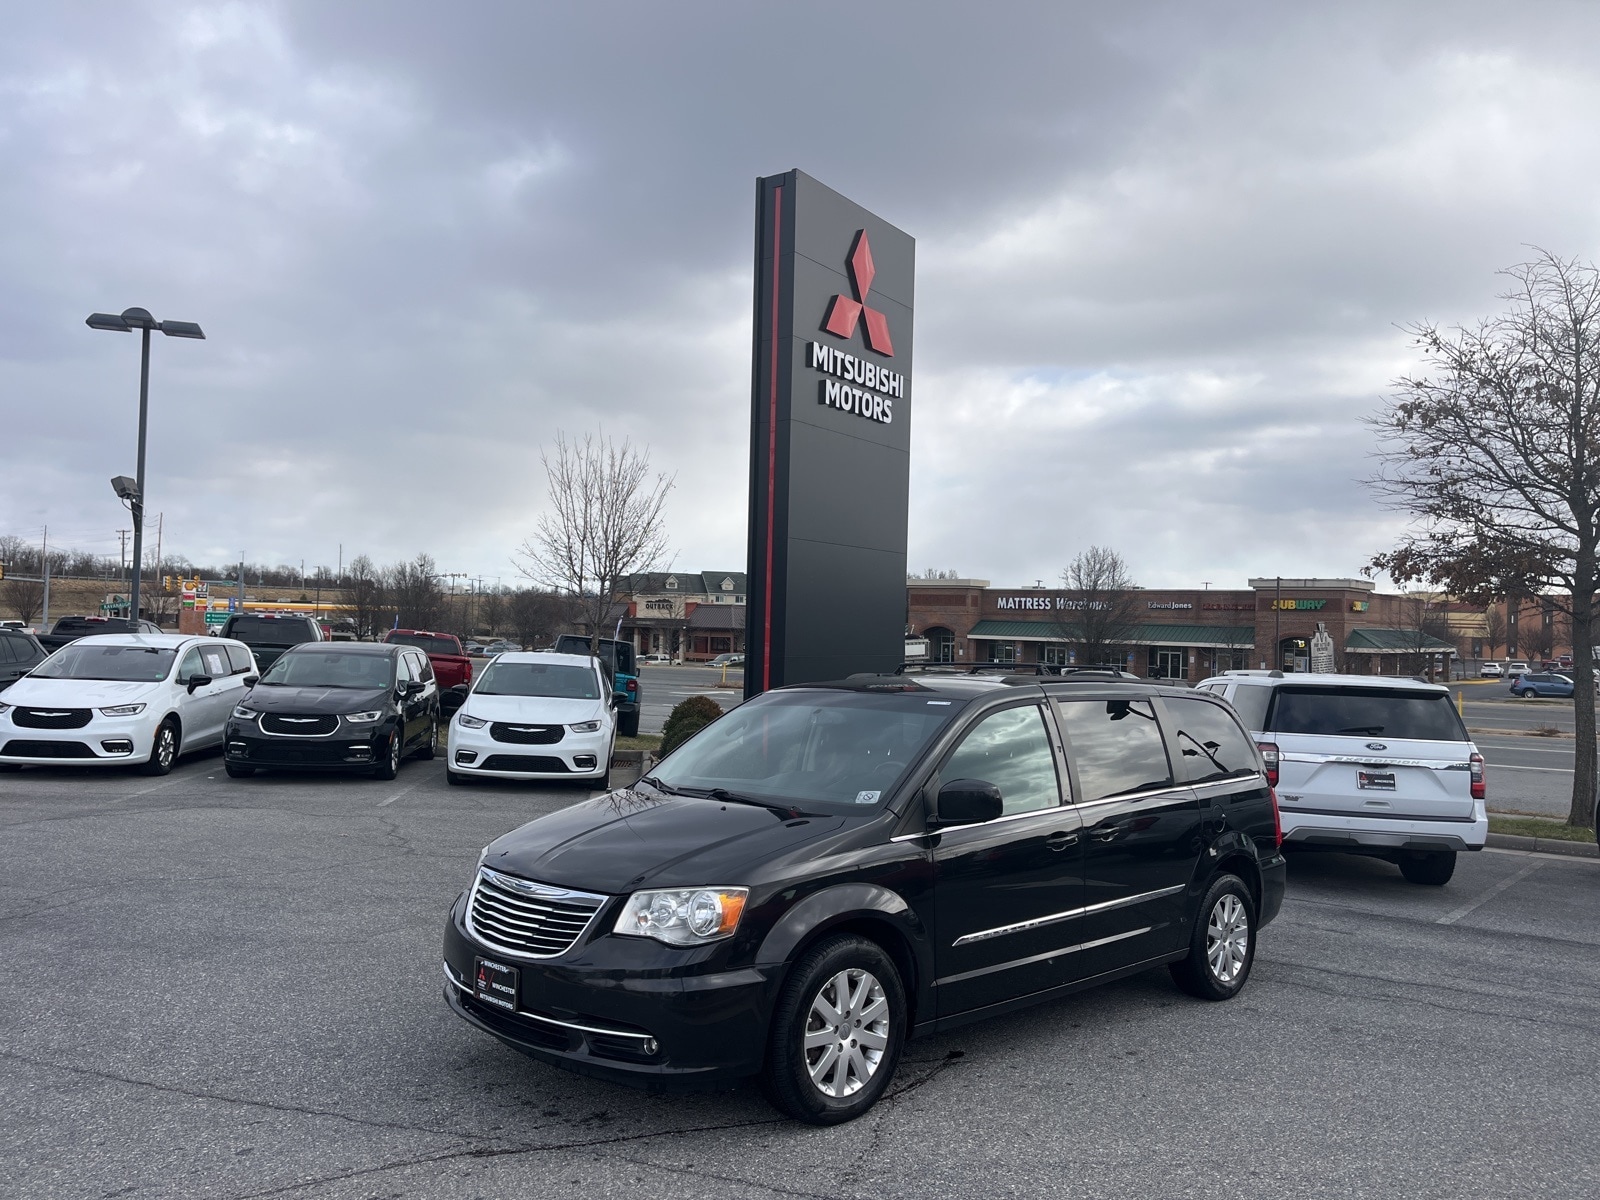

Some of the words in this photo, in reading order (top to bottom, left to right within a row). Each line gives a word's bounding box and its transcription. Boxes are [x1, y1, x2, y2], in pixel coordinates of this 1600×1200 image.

[812, 341, 904, 398] MITSUBISHI
[825, 379, 892, 424] MOTORS
[997, 597, 1052, 610] MATTRESS
[1172, 601, 1192, 610] Jones
[1271, 600, 1327, 610] SUBWAY
[1334, 756, 1420, 765] EXPEDITION
